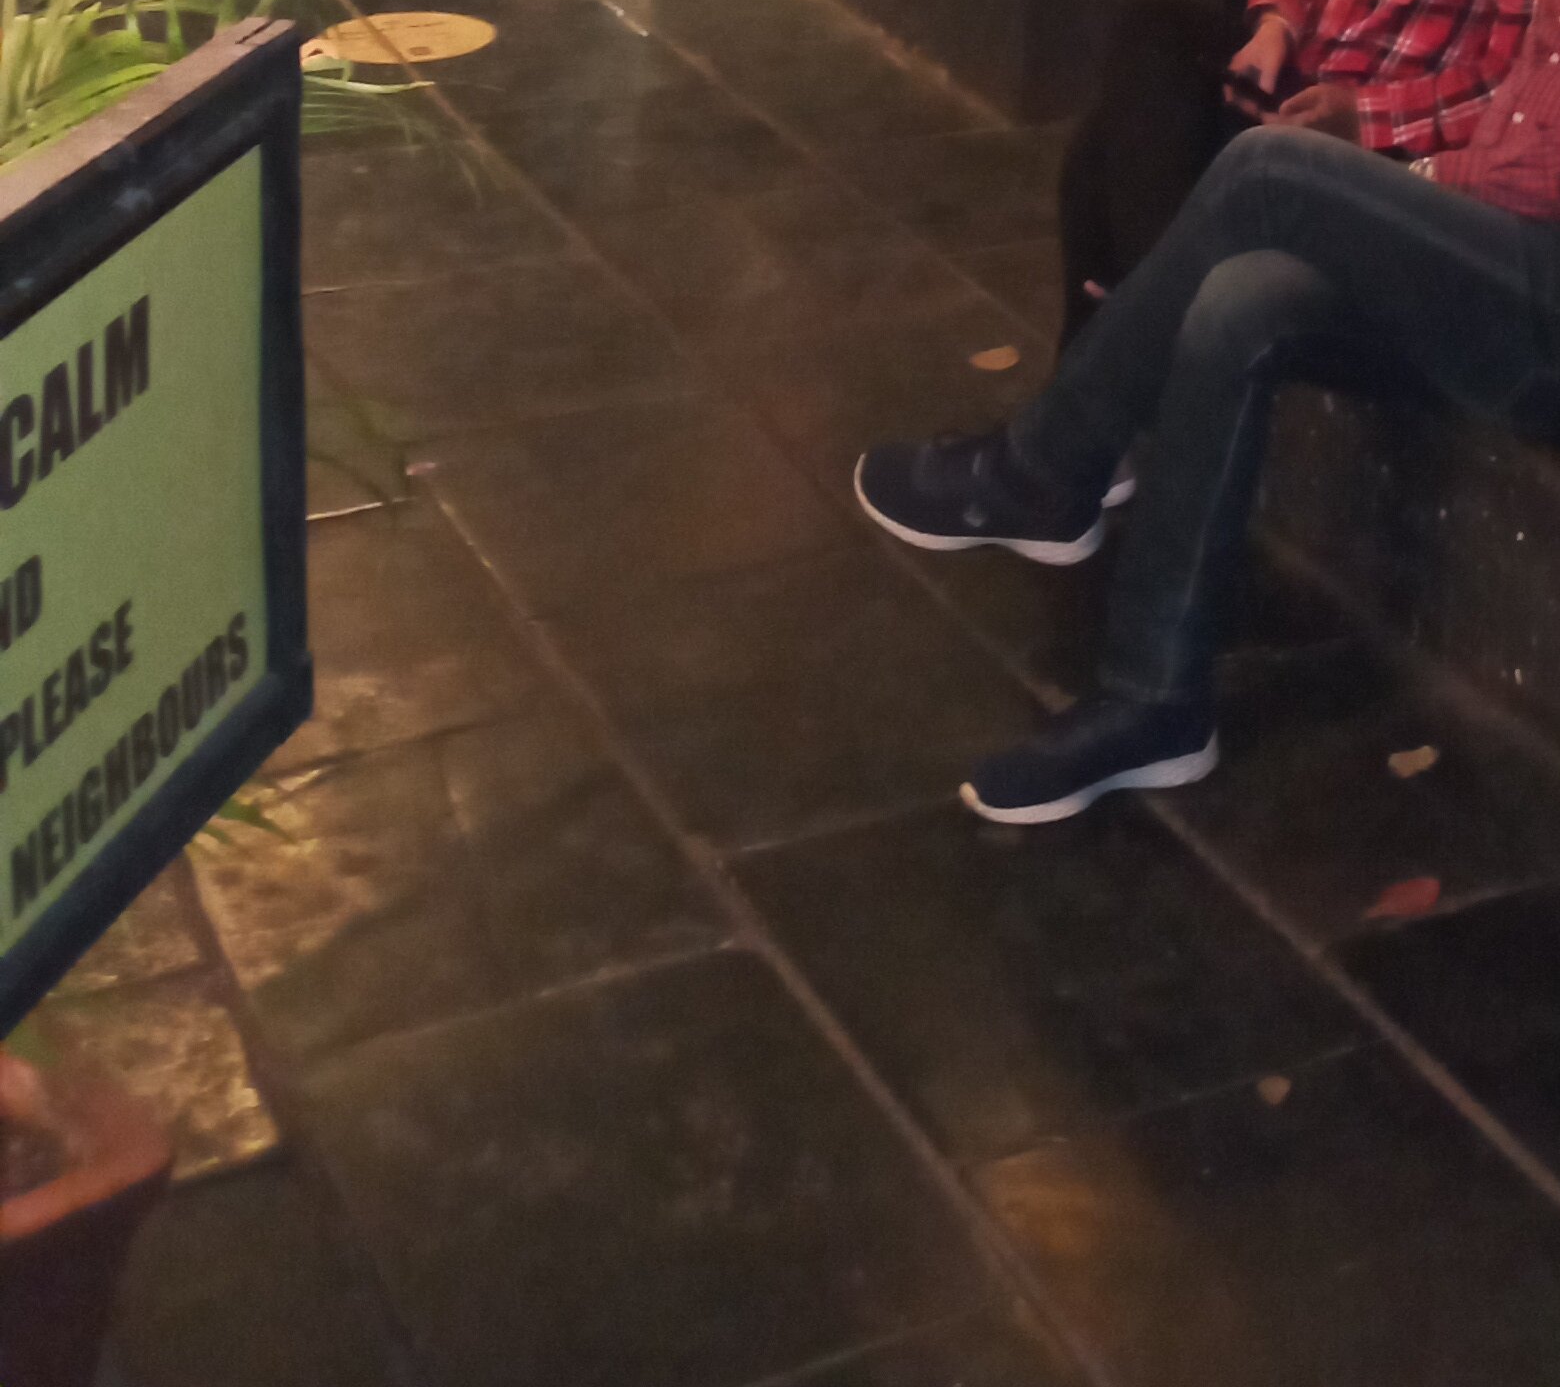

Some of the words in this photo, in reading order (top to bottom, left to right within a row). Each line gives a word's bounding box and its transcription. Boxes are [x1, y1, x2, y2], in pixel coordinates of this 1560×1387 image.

[0, 294, 150, 510] CALM
[0, 597, 134, 795] PLEASE
[11, 611, 248, 921] NEIGHBOURS
